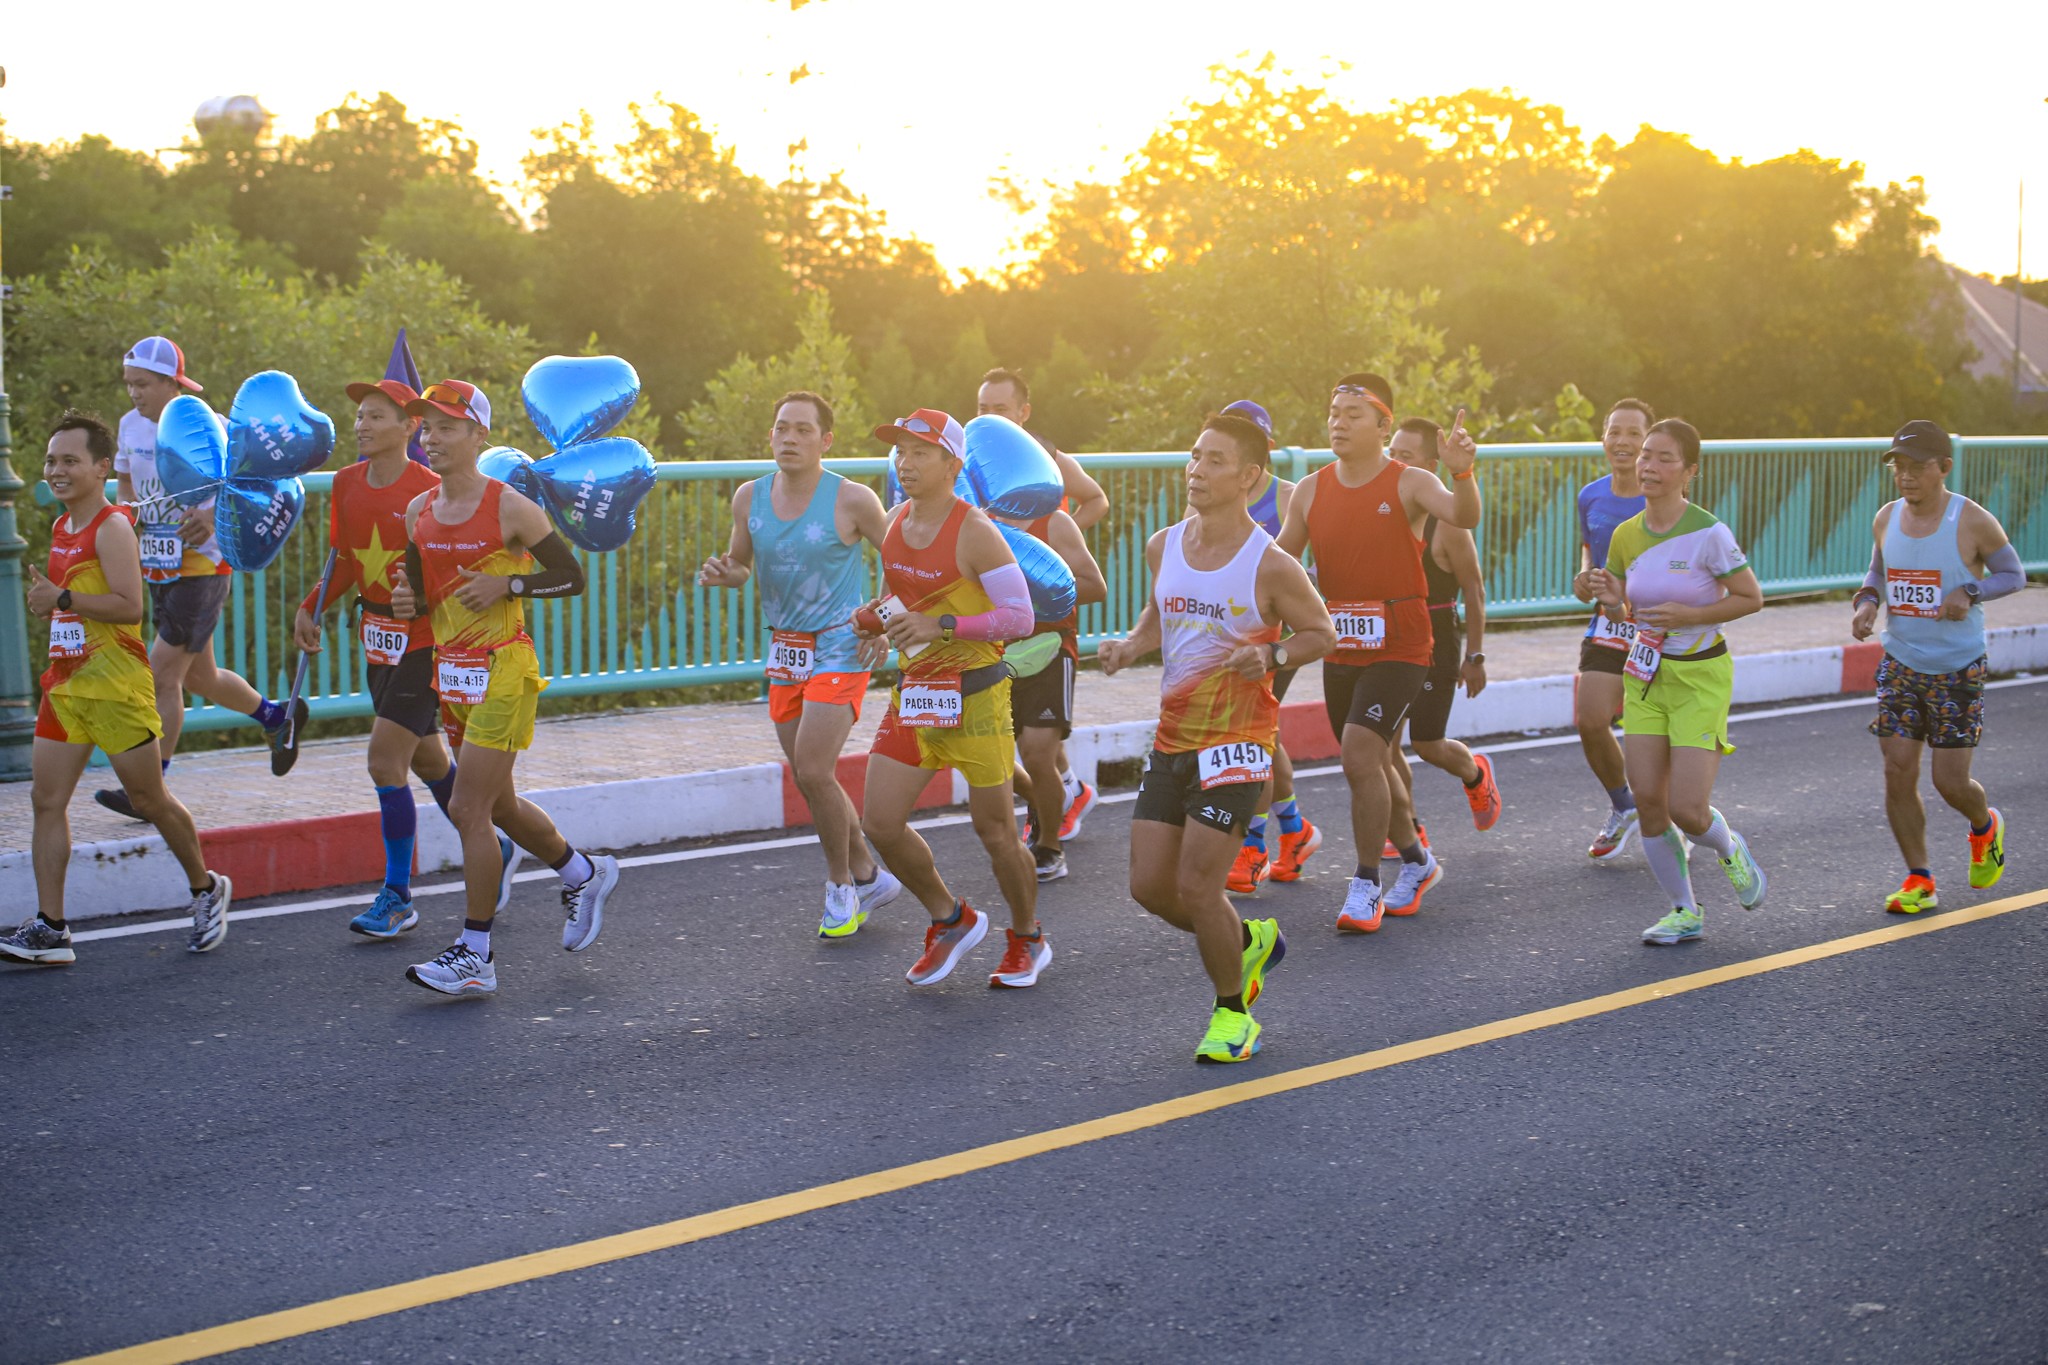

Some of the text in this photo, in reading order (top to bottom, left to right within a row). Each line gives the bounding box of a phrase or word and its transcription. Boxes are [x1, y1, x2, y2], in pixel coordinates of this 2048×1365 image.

[249, 416, 285, 461] 4H15
[271, 414, 296, 443] FM
[571, 469, 597, 522] 4H15
[593, 489, 614, 520] FM
[254, 490, 285, 537] 4H15
[272, 509, 293, 538] FM
[143, 539, 175, 556] 21548
[1893, 585, 1934, 604] 41253
[1164, 597, 1226, 620] HDBank
[1335, 618, 1374, 635] 41181
[368, 629, 403, 651] 41360
[774, 646, 807, 667] 41599
[905, 698, 957, 709] PACER-4:15
[1217, 808, 1232, 825] T8
